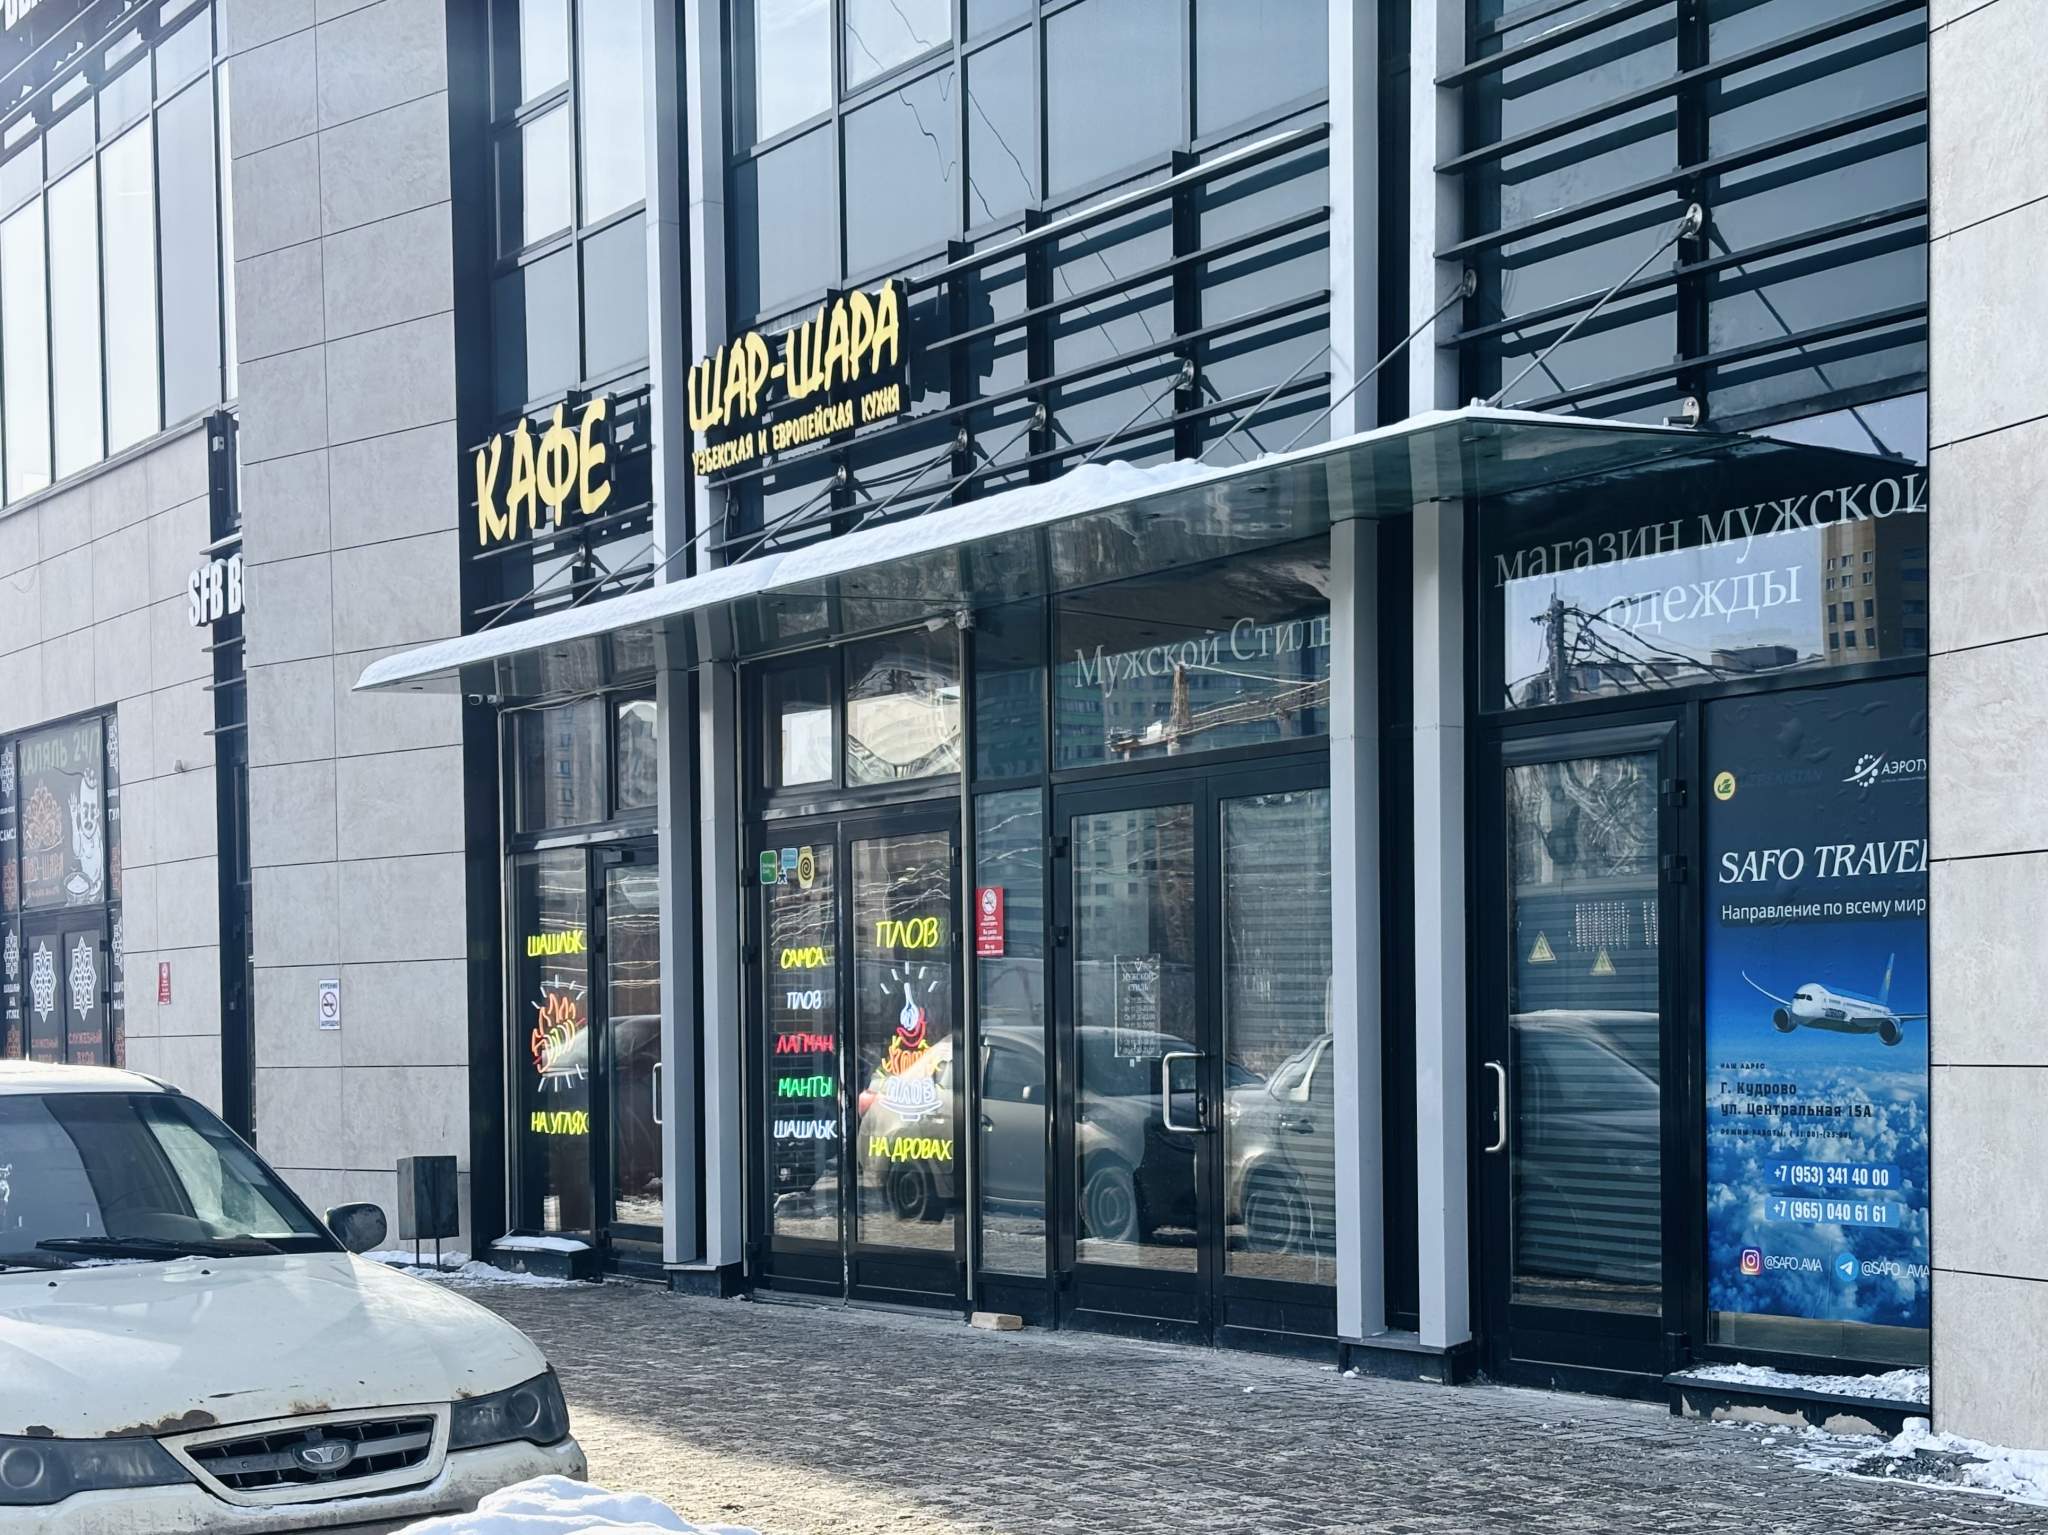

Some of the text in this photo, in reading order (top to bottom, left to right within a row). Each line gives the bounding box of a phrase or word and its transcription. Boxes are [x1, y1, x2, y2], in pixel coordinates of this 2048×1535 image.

[688, 279, 899, 432] ШАР-ШАРА
[692, 383, 900, 475] УЗБЕКСКАЯ И ЕВРОПЕЙСКАЯ КУХНЯ
[476, 399, 611, 546] КАФЕ
[1494, 519, 1684, 588] магазин
[188, 556, 245, 627] SFB B
[1607, 566, 1803, 635] одежды
[20, 737, 68, 776] ХАЛЯЛЬ
[1719, 847, 1805, 884] SAFO
[1722, 902, 1821, 924] Направление
[1824, 903, 1842, 916] по
[1846, 899, 1891, 918] всему
[528, 929, 587, 957] ШАШЛЫК
[875, 916, 939, 949] ПЛОВ
[780, 946, 827, 970] САМСА
[786, 989, 822, 1010] ПЛОВ
[776, 1032, 833, 1054] ЛАГМАН
[778, 1075, 832, 1097] МАНТЫ
[1737, 1082, 1797, 1097] Кудрово
[531, 1110, 589, 1136] НА УГЛЯХ
[1721, 1103, 1741, 1117] ул.
[1746, 1103, 1842, 1118] Центральная
[773, 1119, 838, 1140] ШАШЛЫК
[868, 1135, 953, 1163] НА ДРОВАХ
[1774, 1165, 1889, 1187] +7 (953) 341 40 00
[1773, 1201, 1886, 1223] +7 (965) 040 61 61
